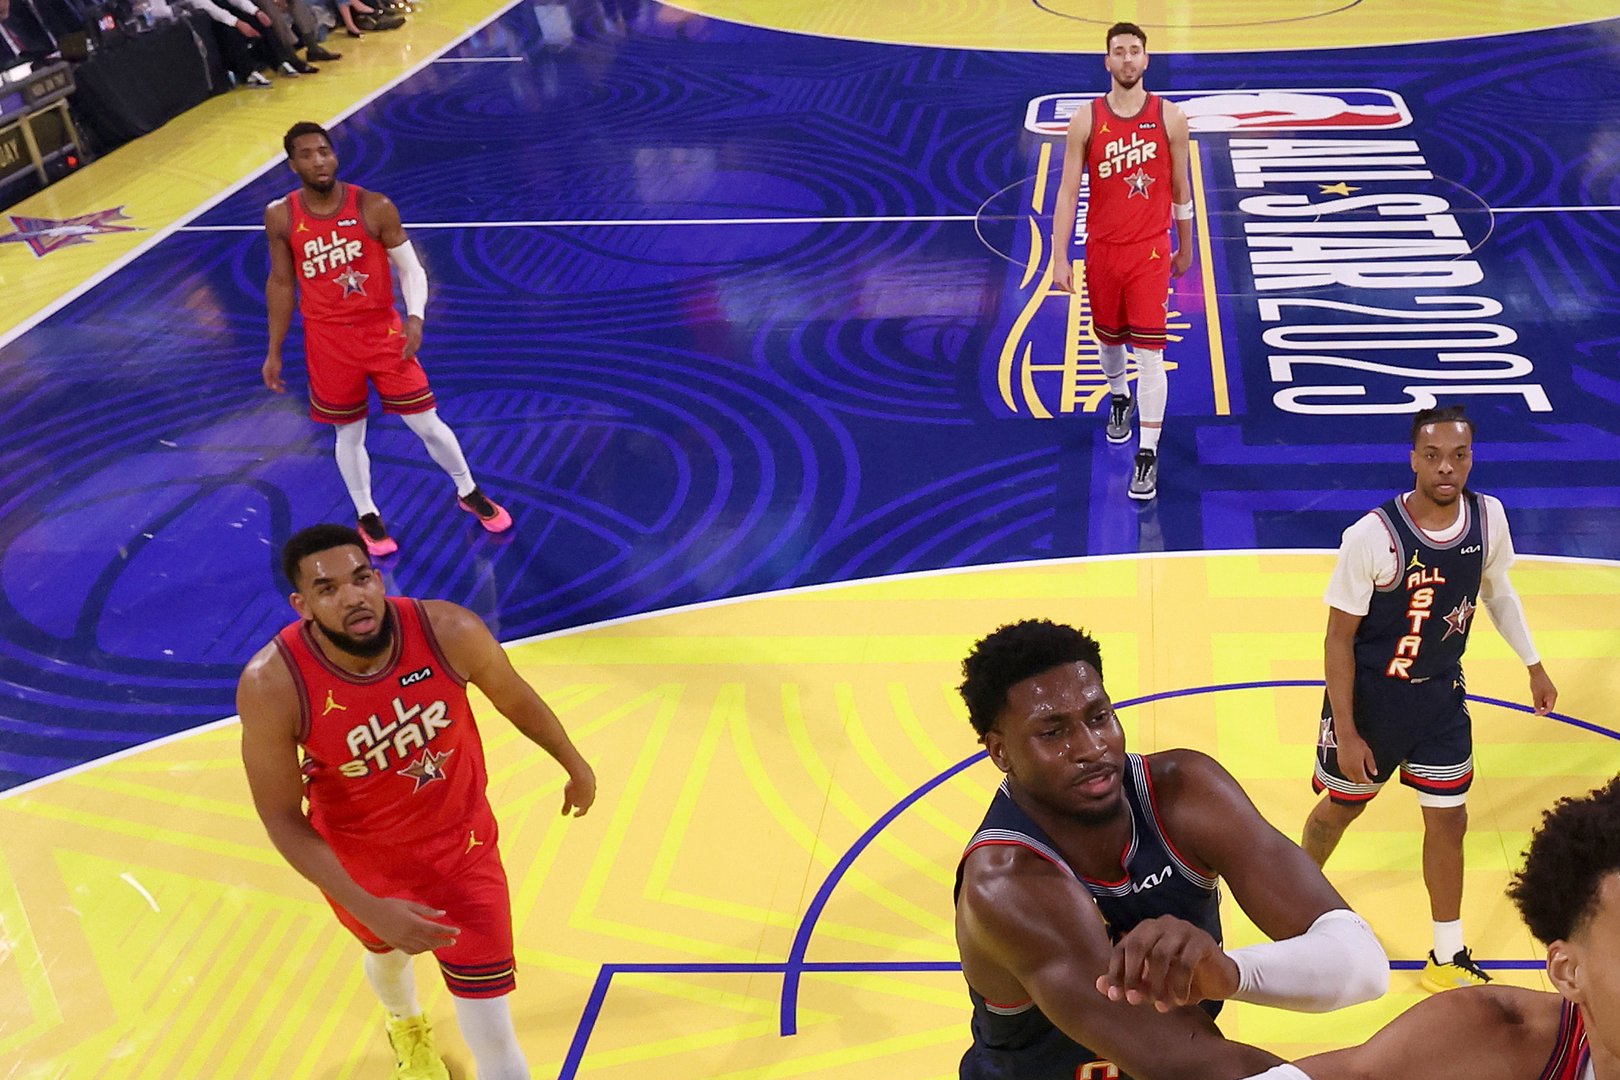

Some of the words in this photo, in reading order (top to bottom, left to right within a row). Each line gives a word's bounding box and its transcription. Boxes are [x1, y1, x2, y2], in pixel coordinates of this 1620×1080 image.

[1098, 141, 1157, 179] STAR
[1105, 132, 1145, 159] ALL
[1229, 139, 1434, 188] ALL
[302, 240, 364, 278] STAR
[303, 230, 348, 259] ALL
[1239, 194, 1486, 290] STAR
[1258, 295, 1553, 415] 2025
[1406, 567, 1446, 590] ALL
[1386, 587, 1434, 680] STAR
[338, 700, 452, 778] STAR
[346, 697, 422, 757] ALL
